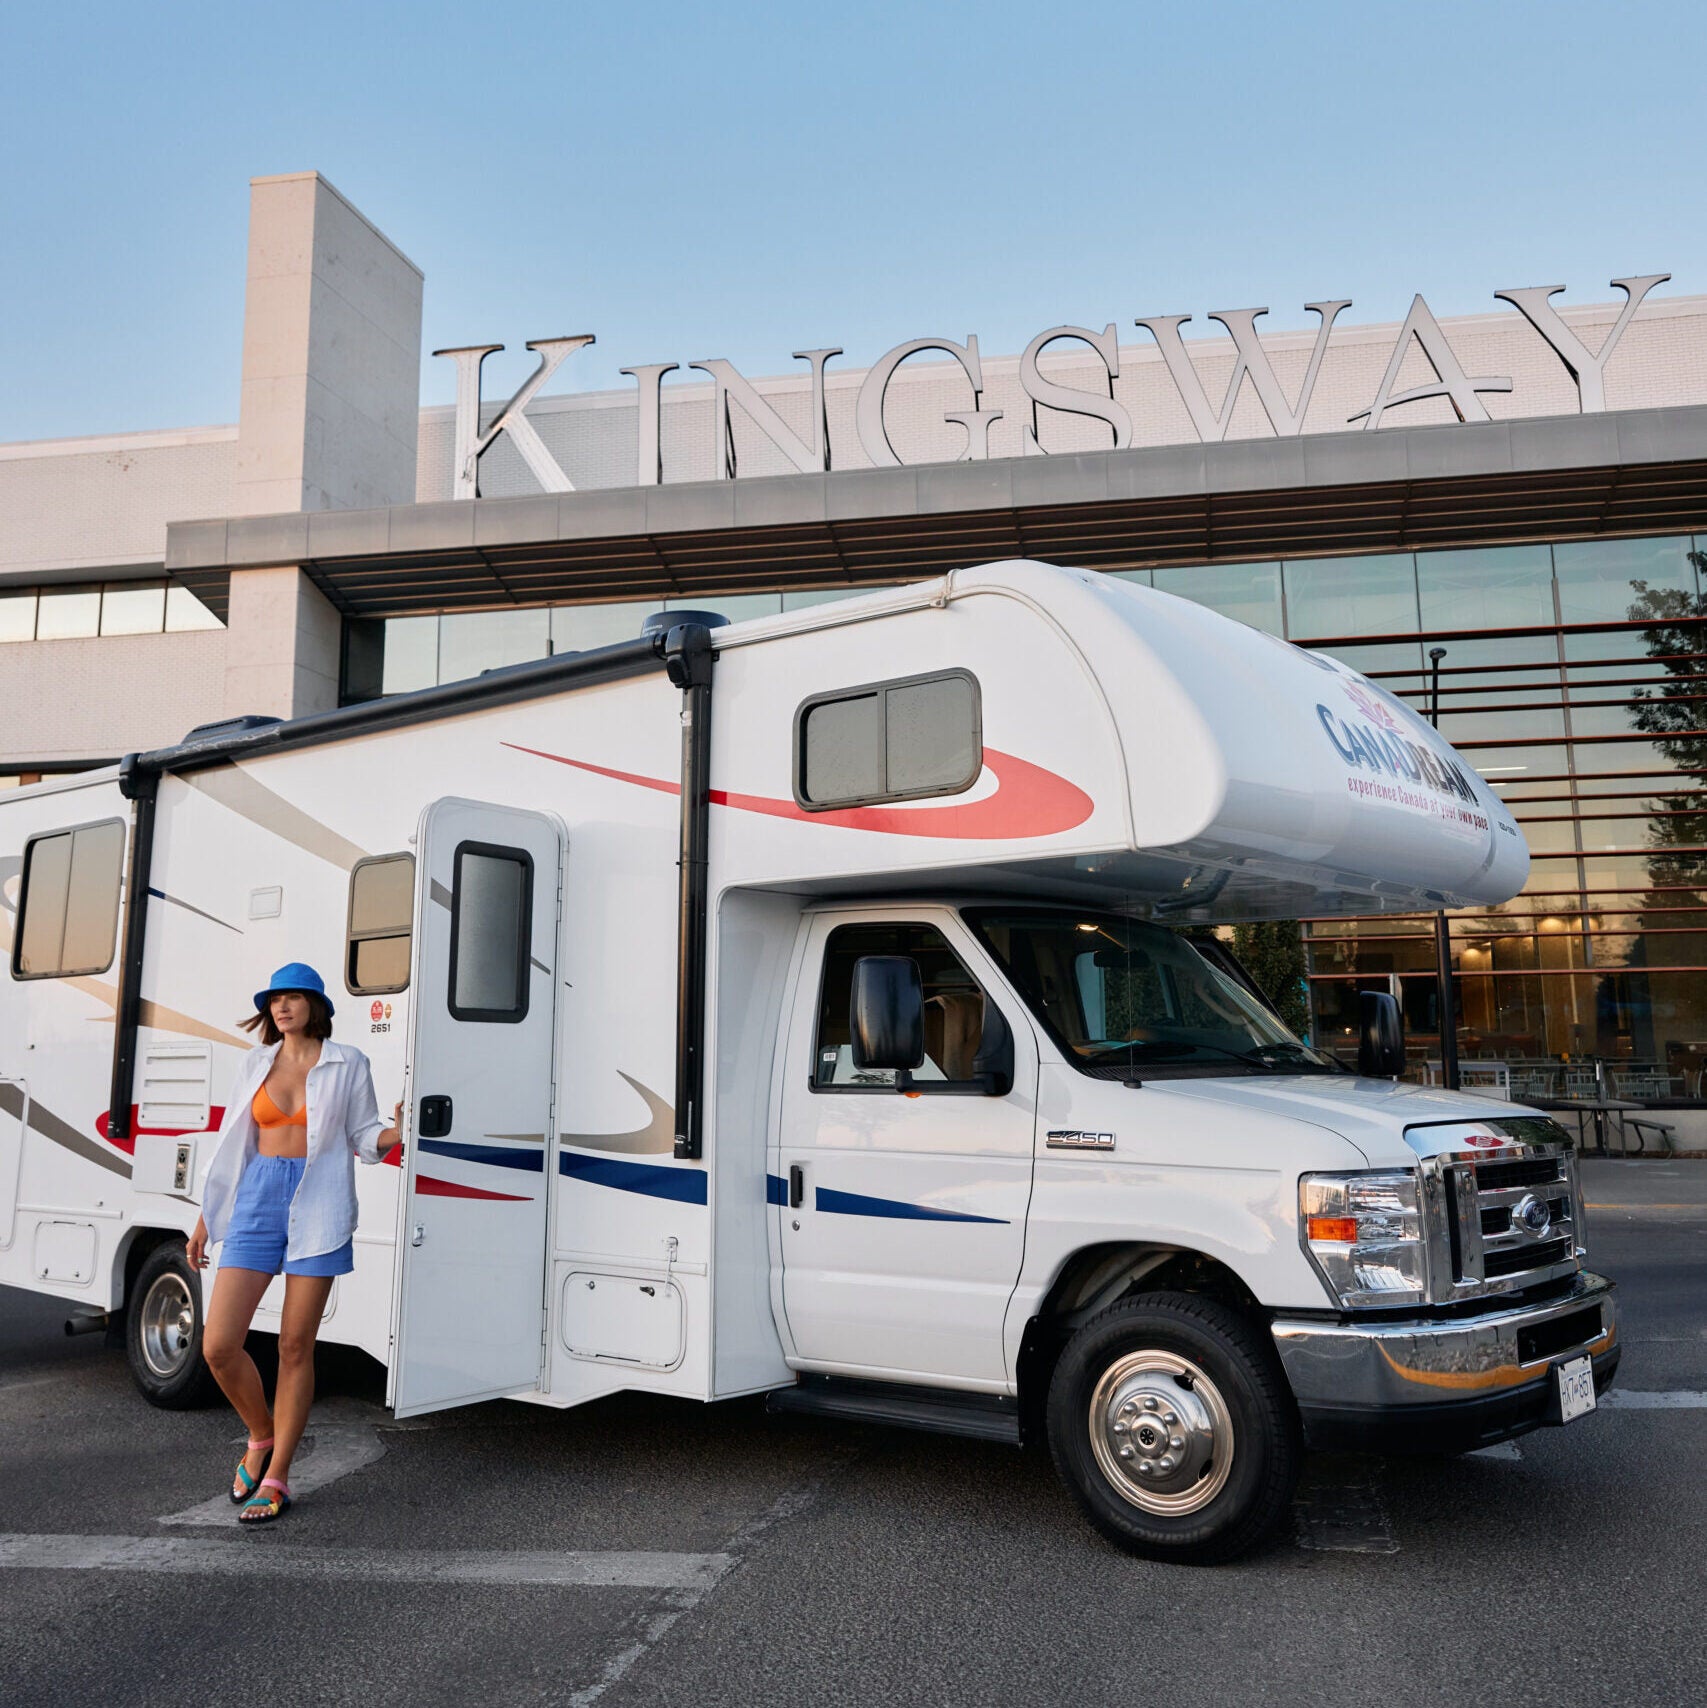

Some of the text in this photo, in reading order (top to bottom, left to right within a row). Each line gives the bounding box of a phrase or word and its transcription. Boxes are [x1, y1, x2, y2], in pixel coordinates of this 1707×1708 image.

[432, 273, 1671, 500] KINGSWAY
[1348, 776, 1397, 802] experience
[1398, 785, 1428, 811] Canada
[1430, 799, 1439, 813] at
[1441, 802, 1456, 819] your
[1458, 809, 1473, 824] own
[1474, 814, 1489, 831] pace
[371, 1023, 391, 1033] 2651
